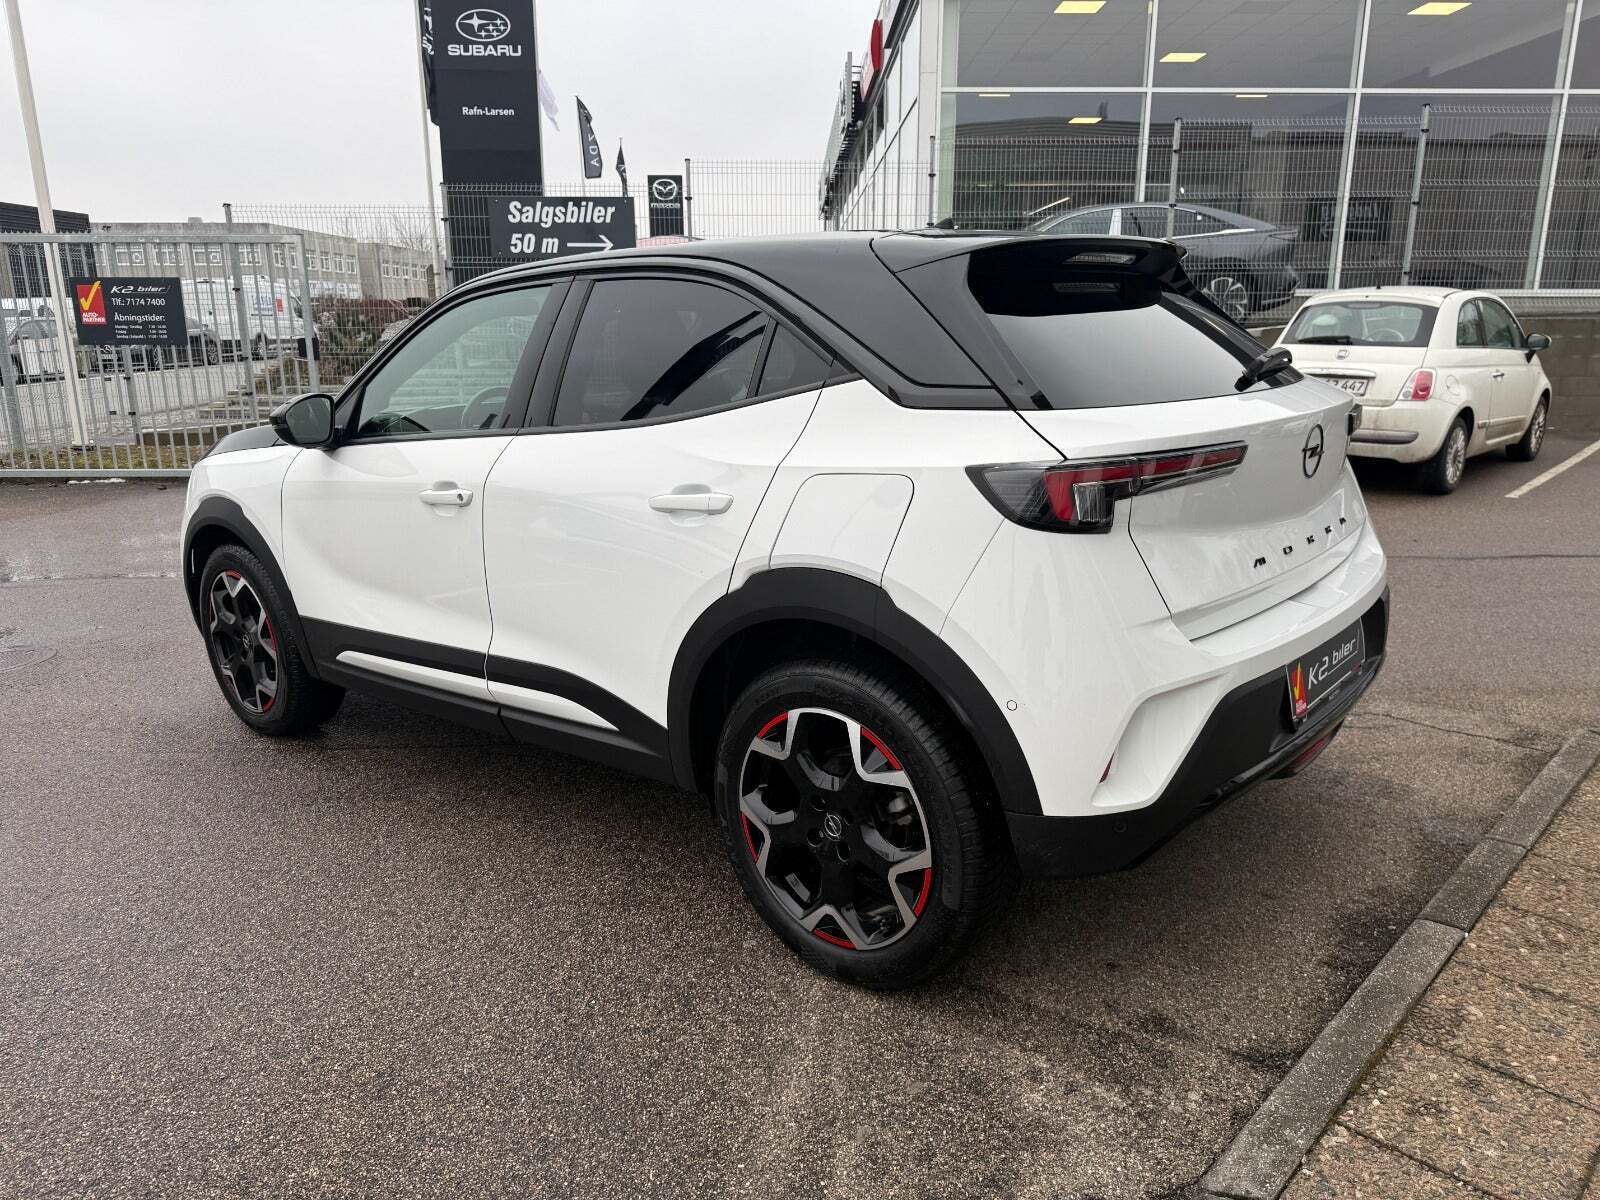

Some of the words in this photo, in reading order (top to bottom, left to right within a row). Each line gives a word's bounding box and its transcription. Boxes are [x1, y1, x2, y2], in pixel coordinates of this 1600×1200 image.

[447, 44, 521, 56] SUBARU
[462, 106, 515, 116] Rafn-Larsen
[507, 201, 616, 228] Salgsbiler
[509, 233, 536, 254] 50
[541, 237, 559, 254] m
[110, 285, 134, 294] K2
[126, 297, 145, 306] 7174
[146, 297, 166, 306] 7400
[114, 312, 166, 323] Åbningstider:
[1341, 380, 1365, 392] 447
[1253, 517, 1347, 569] MOKKA
[1307, 656, 1329, 690] K2
[1332, 638, 1356, 665] biler
